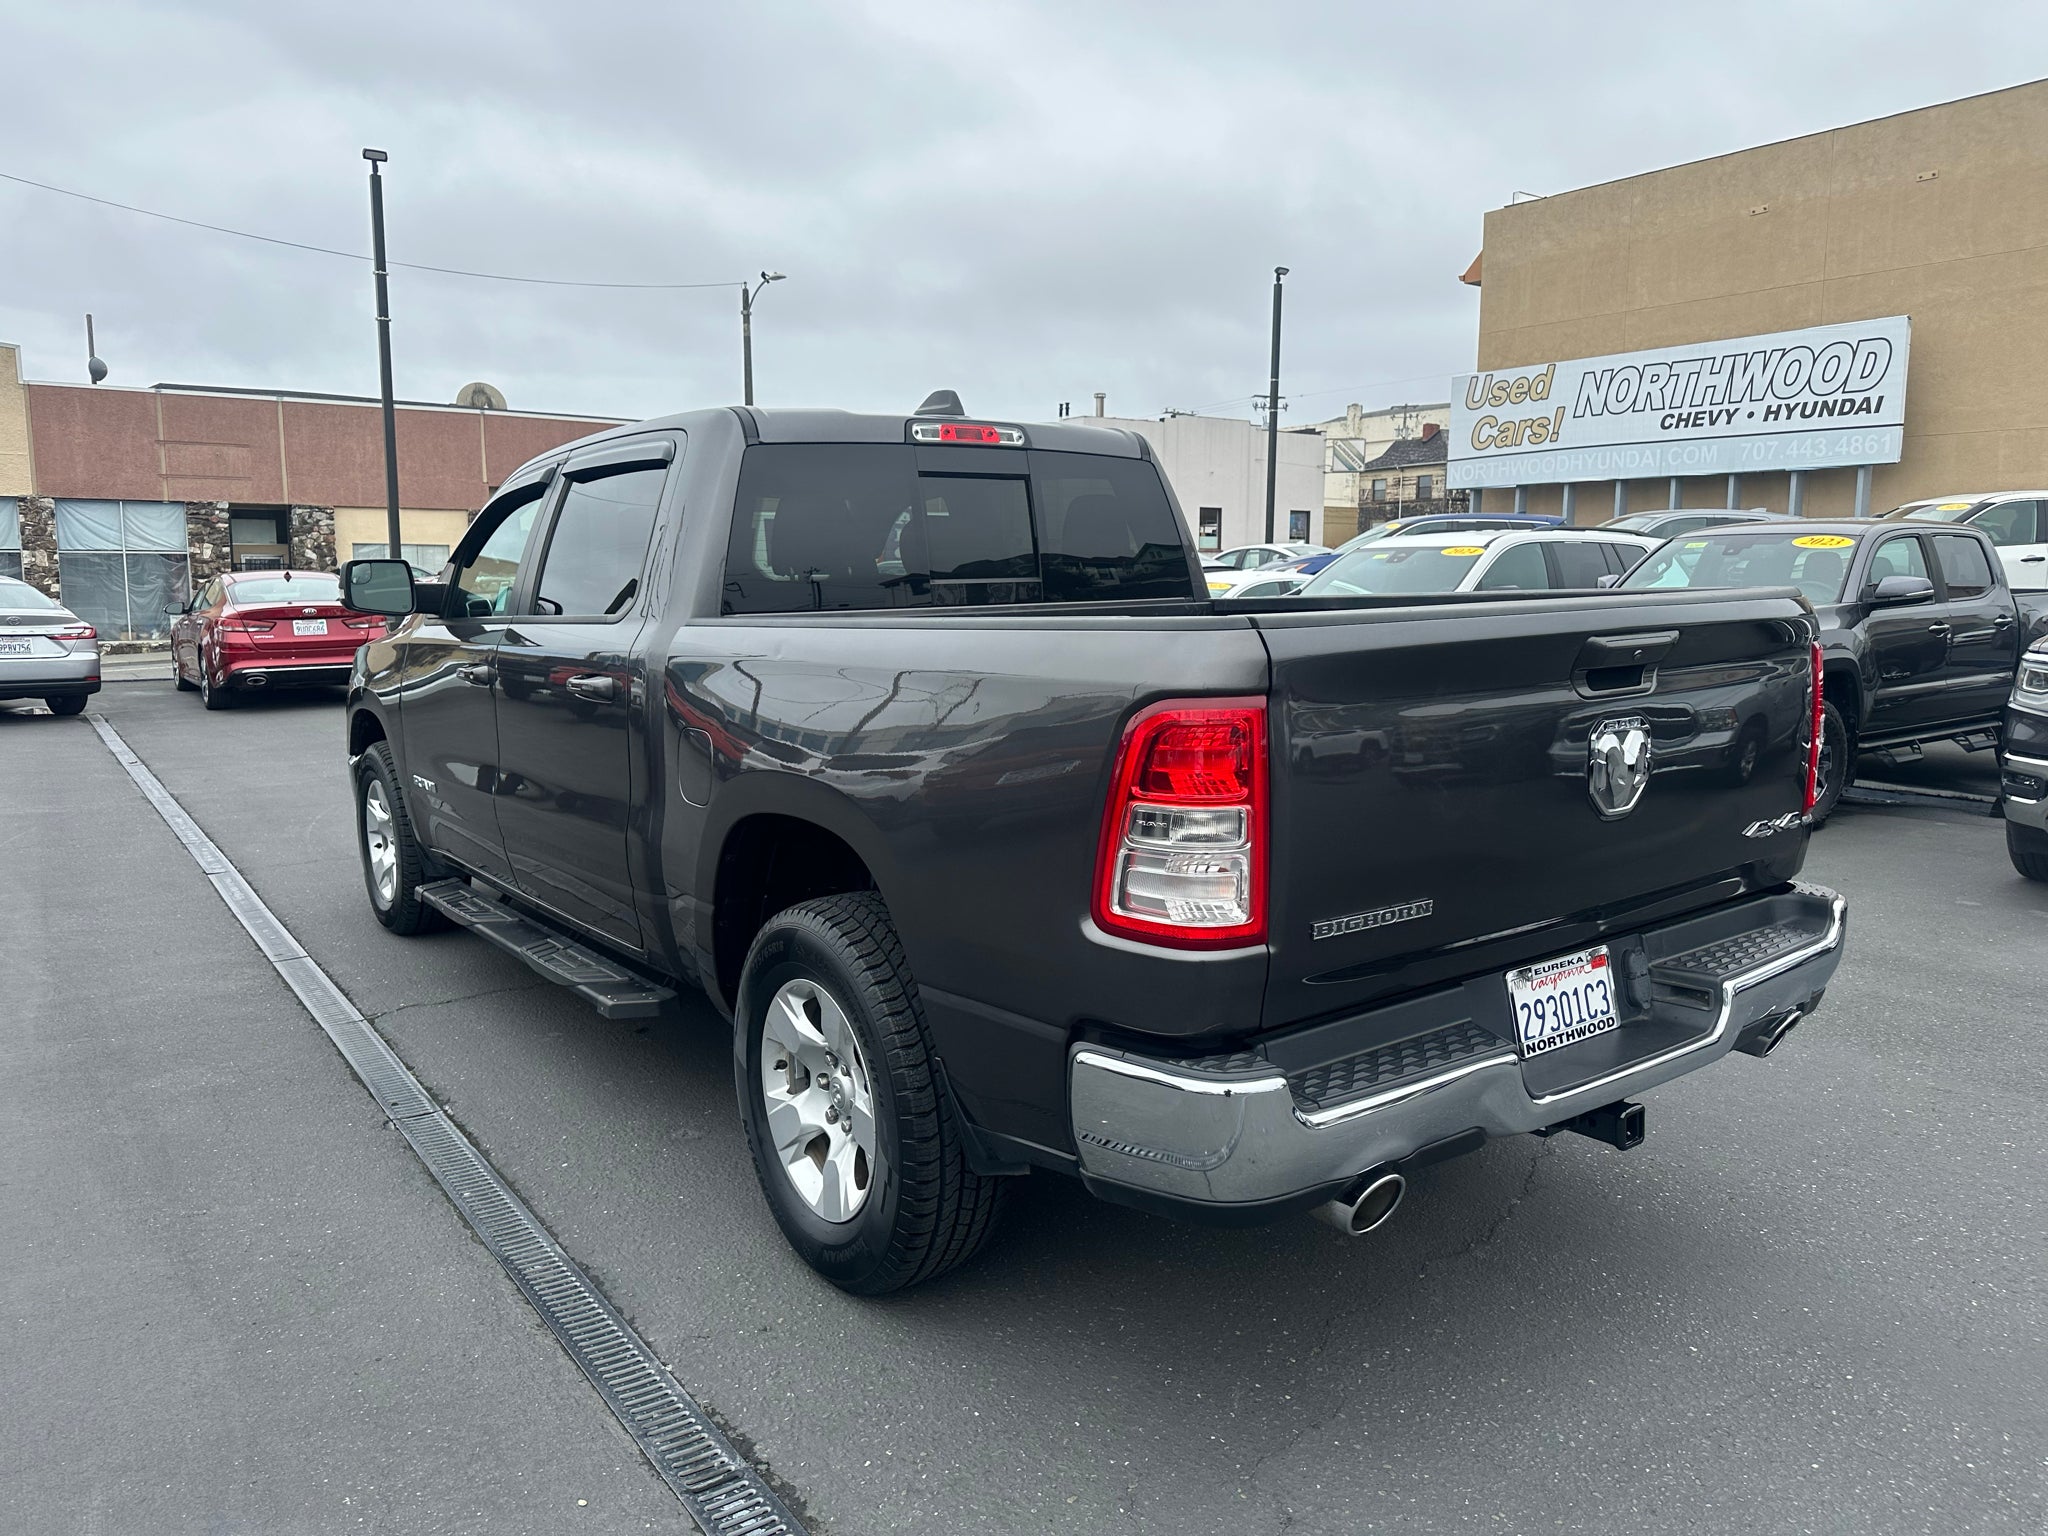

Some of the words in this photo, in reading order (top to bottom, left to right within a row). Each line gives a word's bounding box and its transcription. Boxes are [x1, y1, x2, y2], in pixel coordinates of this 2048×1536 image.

[1465, 363, 1556, 411] Used
[1573, 337, 1893, 418] NORTHWOOD
[1471, 406, 1566, 451] Cars!
[1660, 407, 1740, 430] CHEVY
[1762, 395, 1884, 422] HYUNDAI
[1450, 445, 1718, 483] NORTHWOODHYUNDAI.COM
[1740, 433, 1892, 462] 707.443.4861
[1800, 537, 1845, 546] 2023
[1606, 718, 1641, 730] RAM
[1311, 899, 1433, 940] BIGHORN
[1534, 956, 1584, 976] EUREKA
[1520, 979, 1611, 1041] 29301C3
[1525, 1016, 1616, 1055] NORTHWOOD
